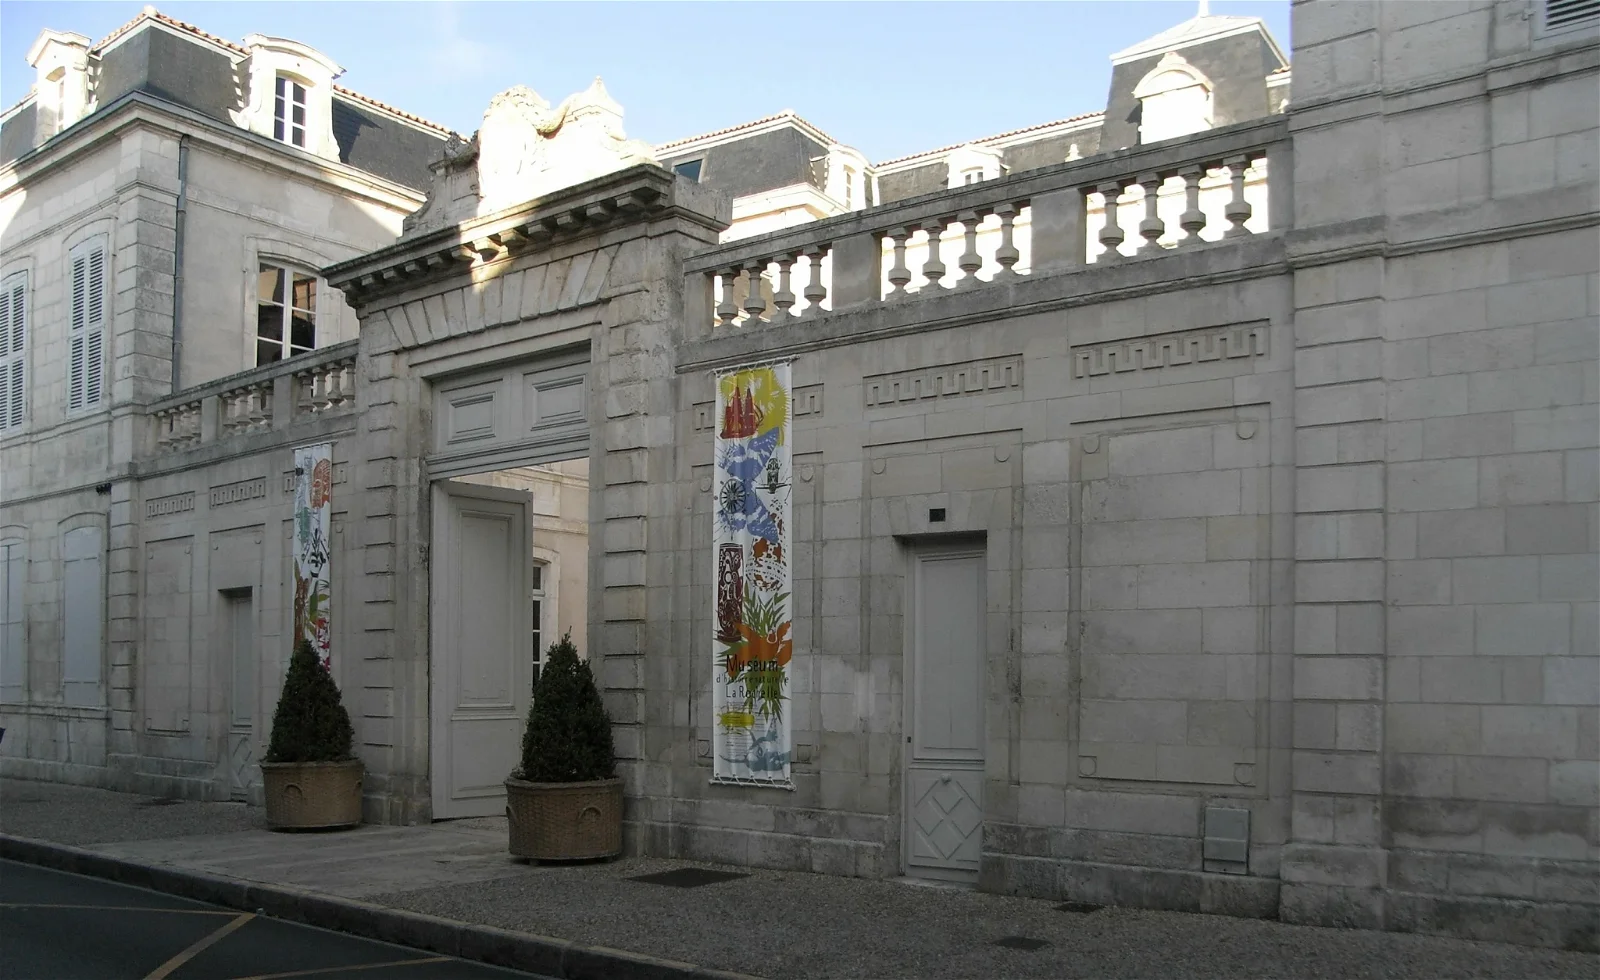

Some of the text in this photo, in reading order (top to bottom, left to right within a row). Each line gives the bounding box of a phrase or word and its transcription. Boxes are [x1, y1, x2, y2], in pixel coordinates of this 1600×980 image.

[726, 654, 778, 672] Muséum
[716, 674, 789, 684] d'hoire naturee
[726, 686, 778, 699] La Rochelle
